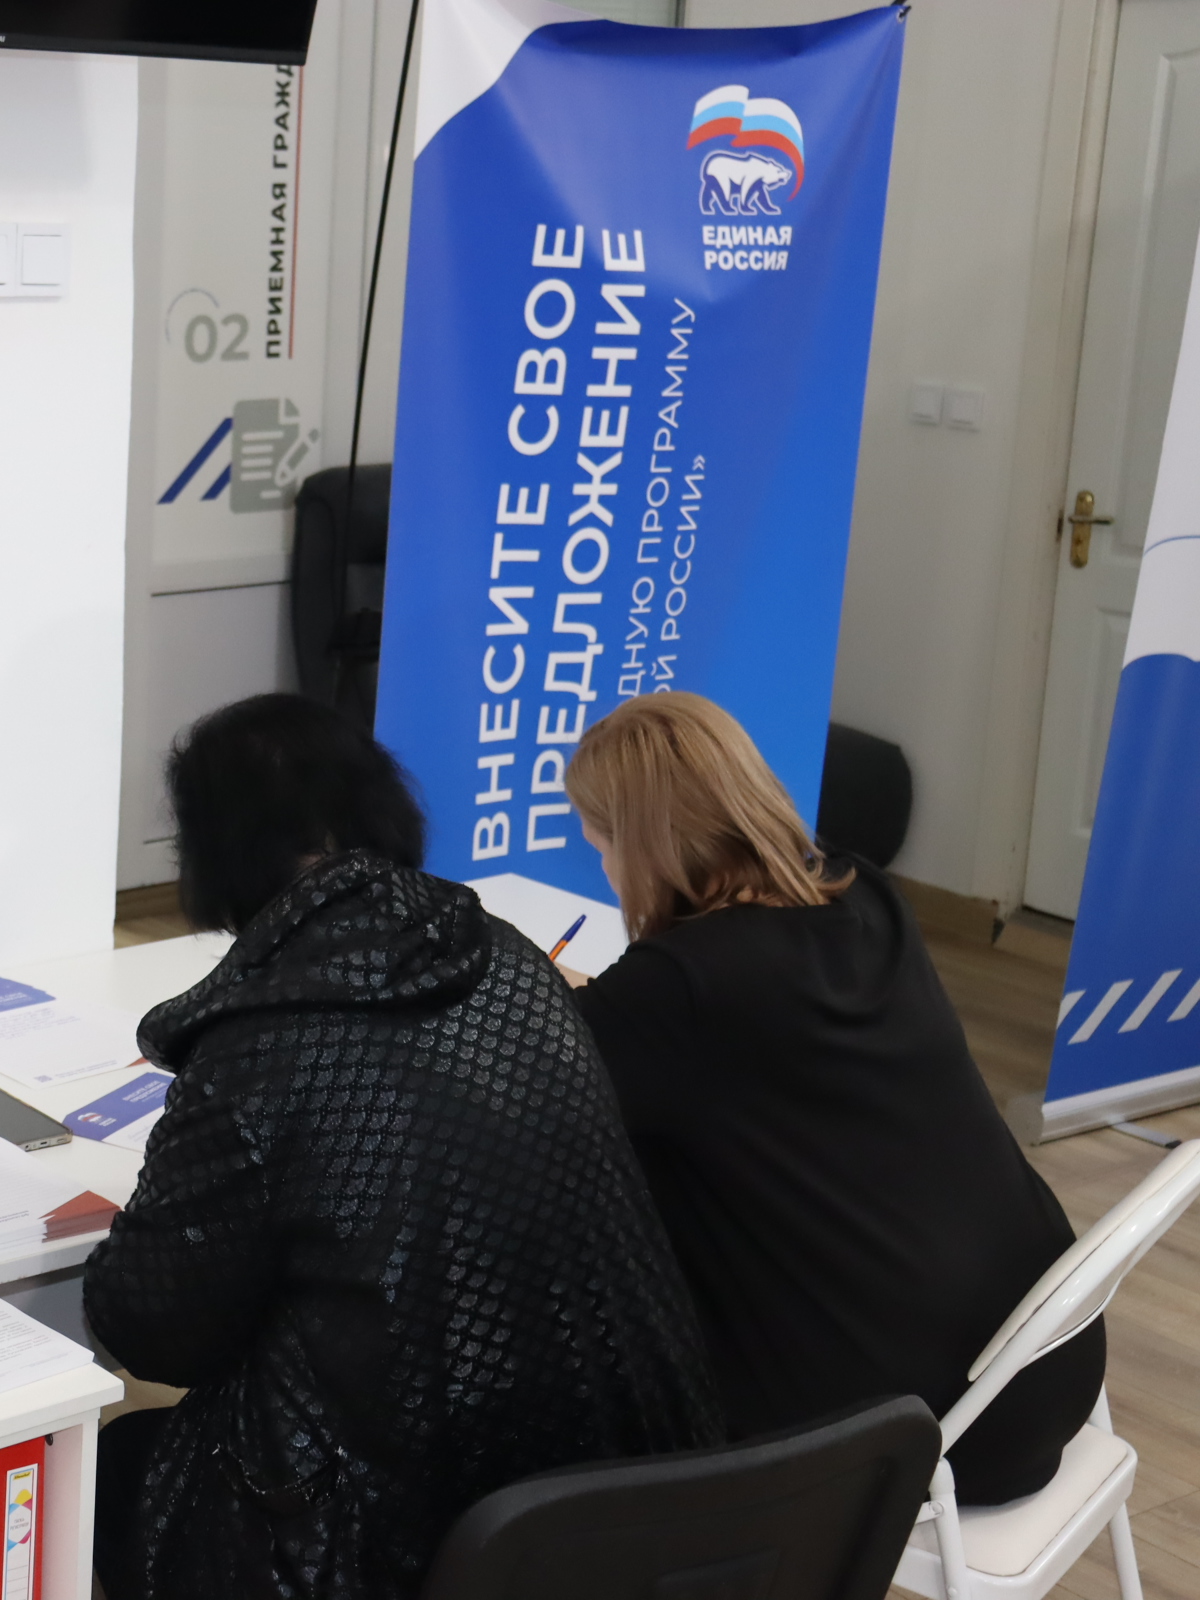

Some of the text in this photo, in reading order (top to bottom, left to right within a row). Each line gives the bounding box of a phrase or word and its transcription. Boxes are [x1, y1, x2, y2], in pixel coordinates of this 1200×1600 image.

[266, 64, 296, 359] ПРИЕМНАЯ ГРАЖД
[702, 225, 792, 249] ЕДИНАЯ
[703, 250, 789, 271] РОССИЯ
[184, 313, 250, 364] 02
[471, 223, 584, 861] ВНЕСИТЕ СВОЕ
[526, 229, 646, 852] ПРЕДЛОЖЕНИЕ
[617, 297, 696, 698] ДНУЮ ПРОГРАММУ
[660, 454, 706, 641] РОССИИ»
